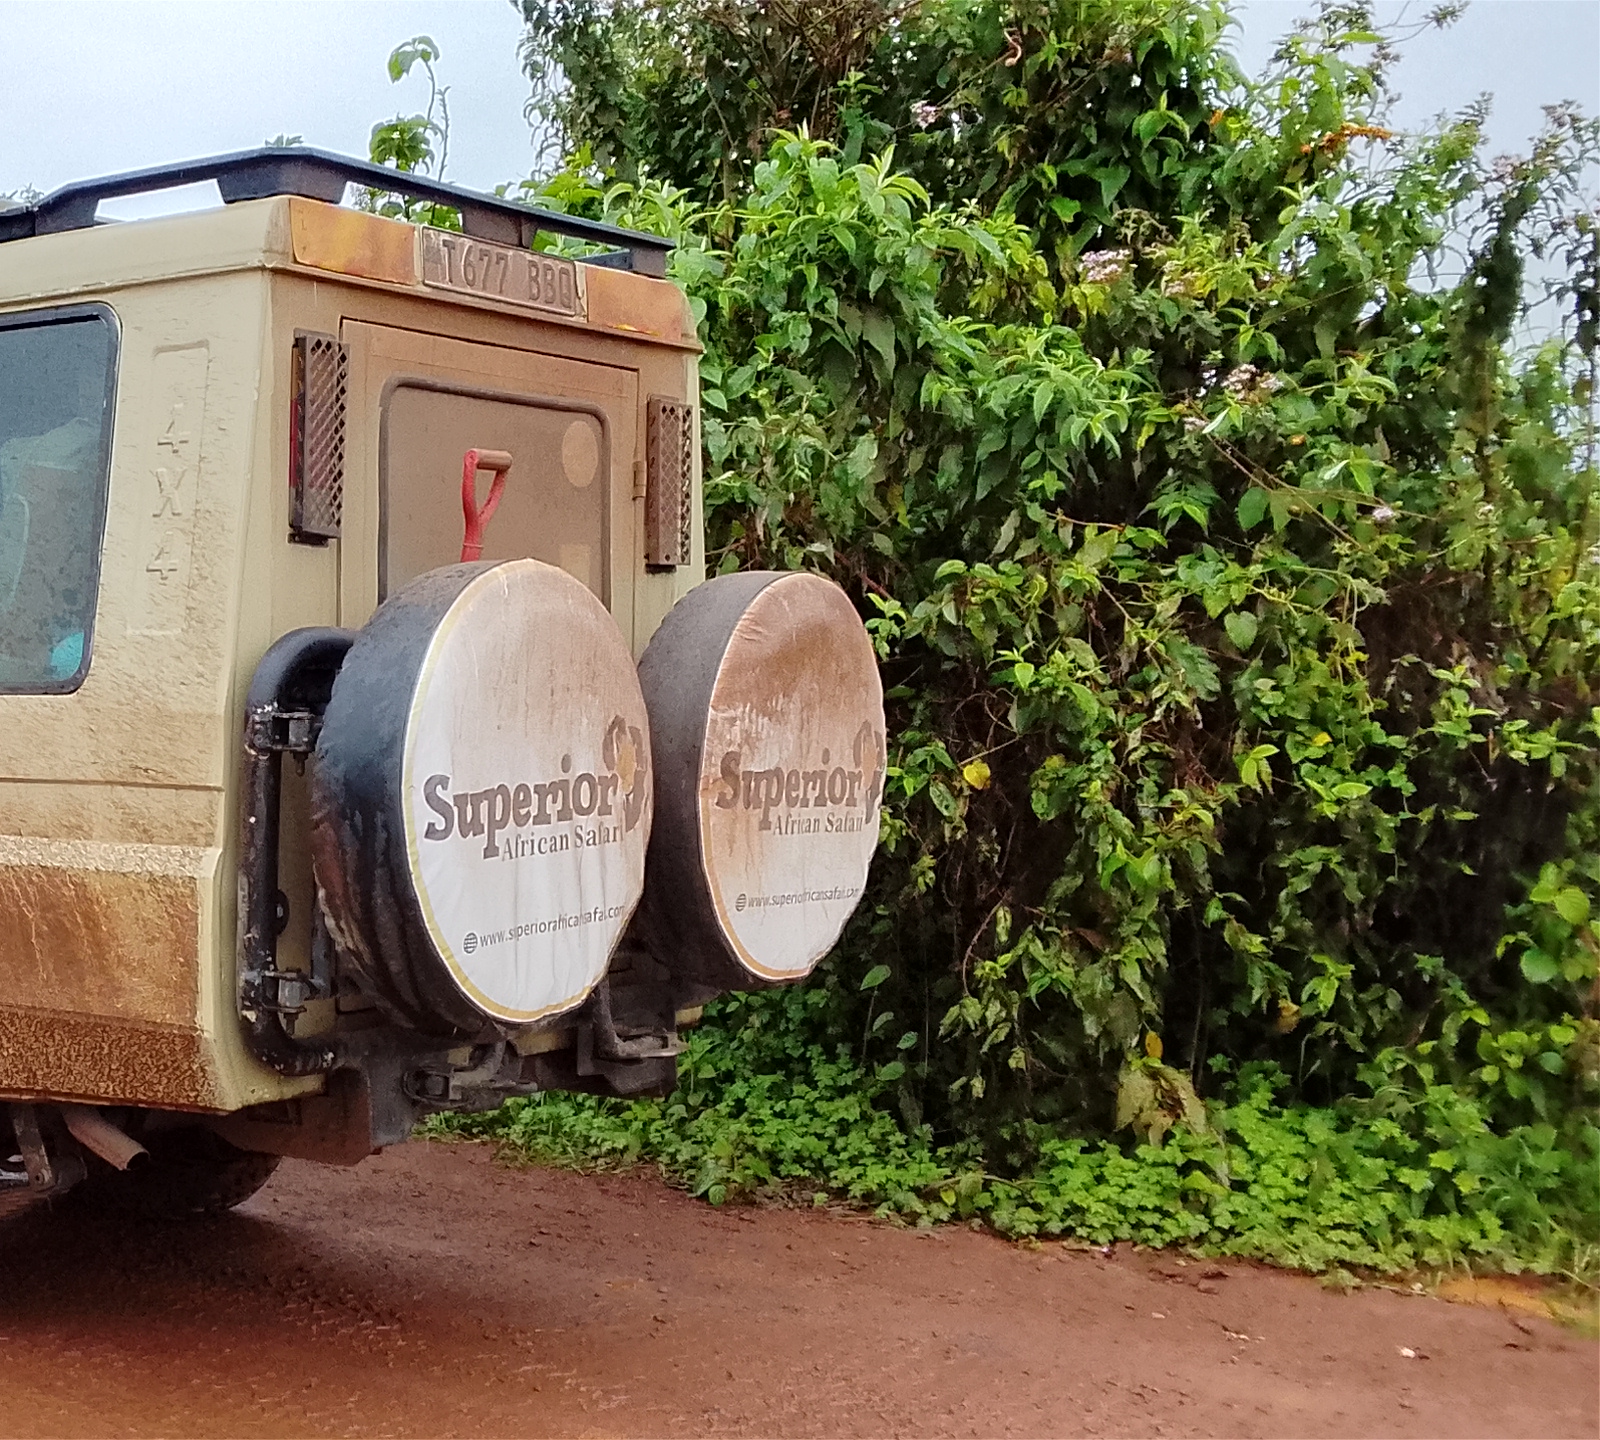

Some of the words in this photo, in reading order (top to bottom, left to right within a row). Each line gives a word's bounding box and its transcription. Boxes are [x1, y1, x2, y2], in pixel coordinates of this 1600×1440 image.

[423, 753, 617, 860] Superior
[715, 748, 863, 831] Superior
[501, 833, 570, 861] African
